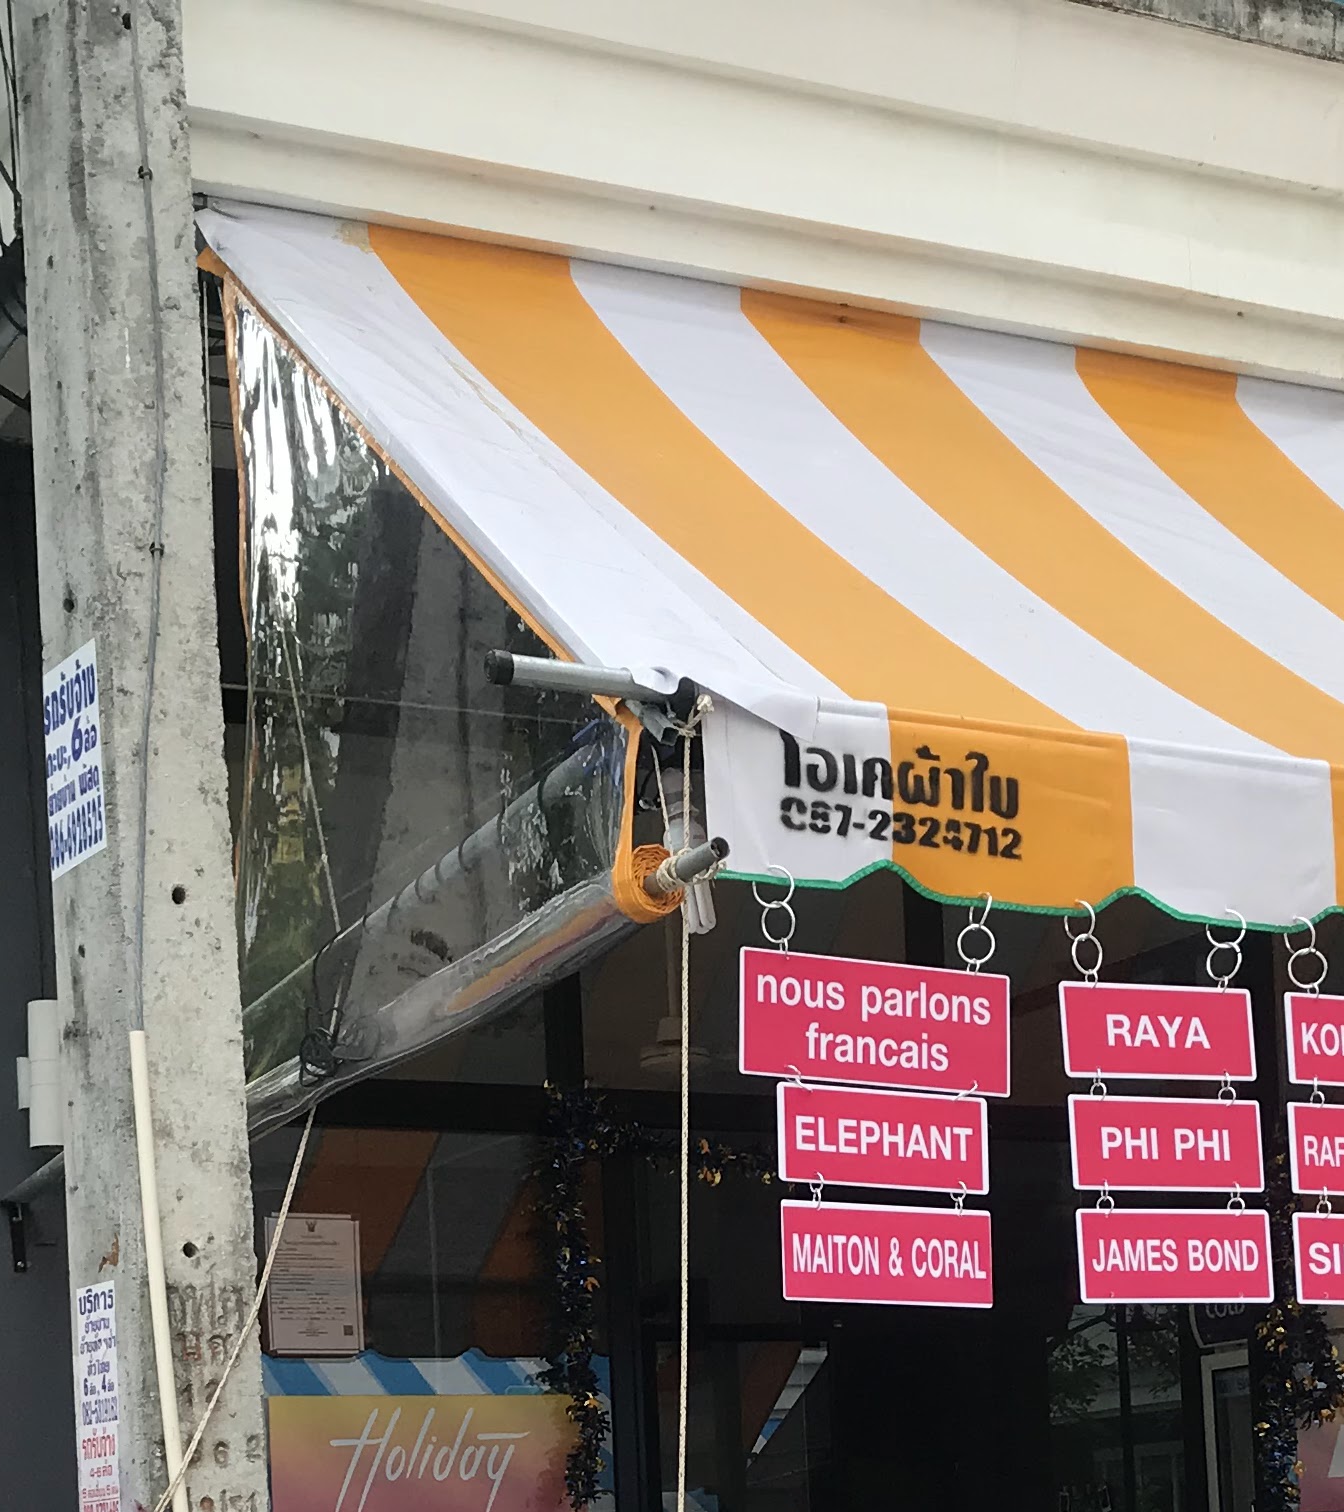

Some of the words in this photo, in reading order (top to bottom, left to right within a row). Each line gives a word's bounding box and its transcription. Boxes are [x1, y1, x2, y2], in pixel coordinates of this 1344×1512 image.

[757, 969, 846, 1010] nous
[861, 982, 991, 1028] parlons
[805, 1029, 949, 1072] francais
[1106, 1013, 1211, 1049] RAYA
[795, 1115, 973, 1162] ELEPHANT
[1100, 1126, 1159, 1160] PHI
[1173, 1128, 1231, 1162] PHI
[792, 1232, 880, 1276] MAITON
[888, 1237, 905, 1277] &
[911, 1237, 987, 1279] CORAL
[1092, 1238, 1179, 1273] JAMES
[1187, 1238, 1259, 1273] BOND
